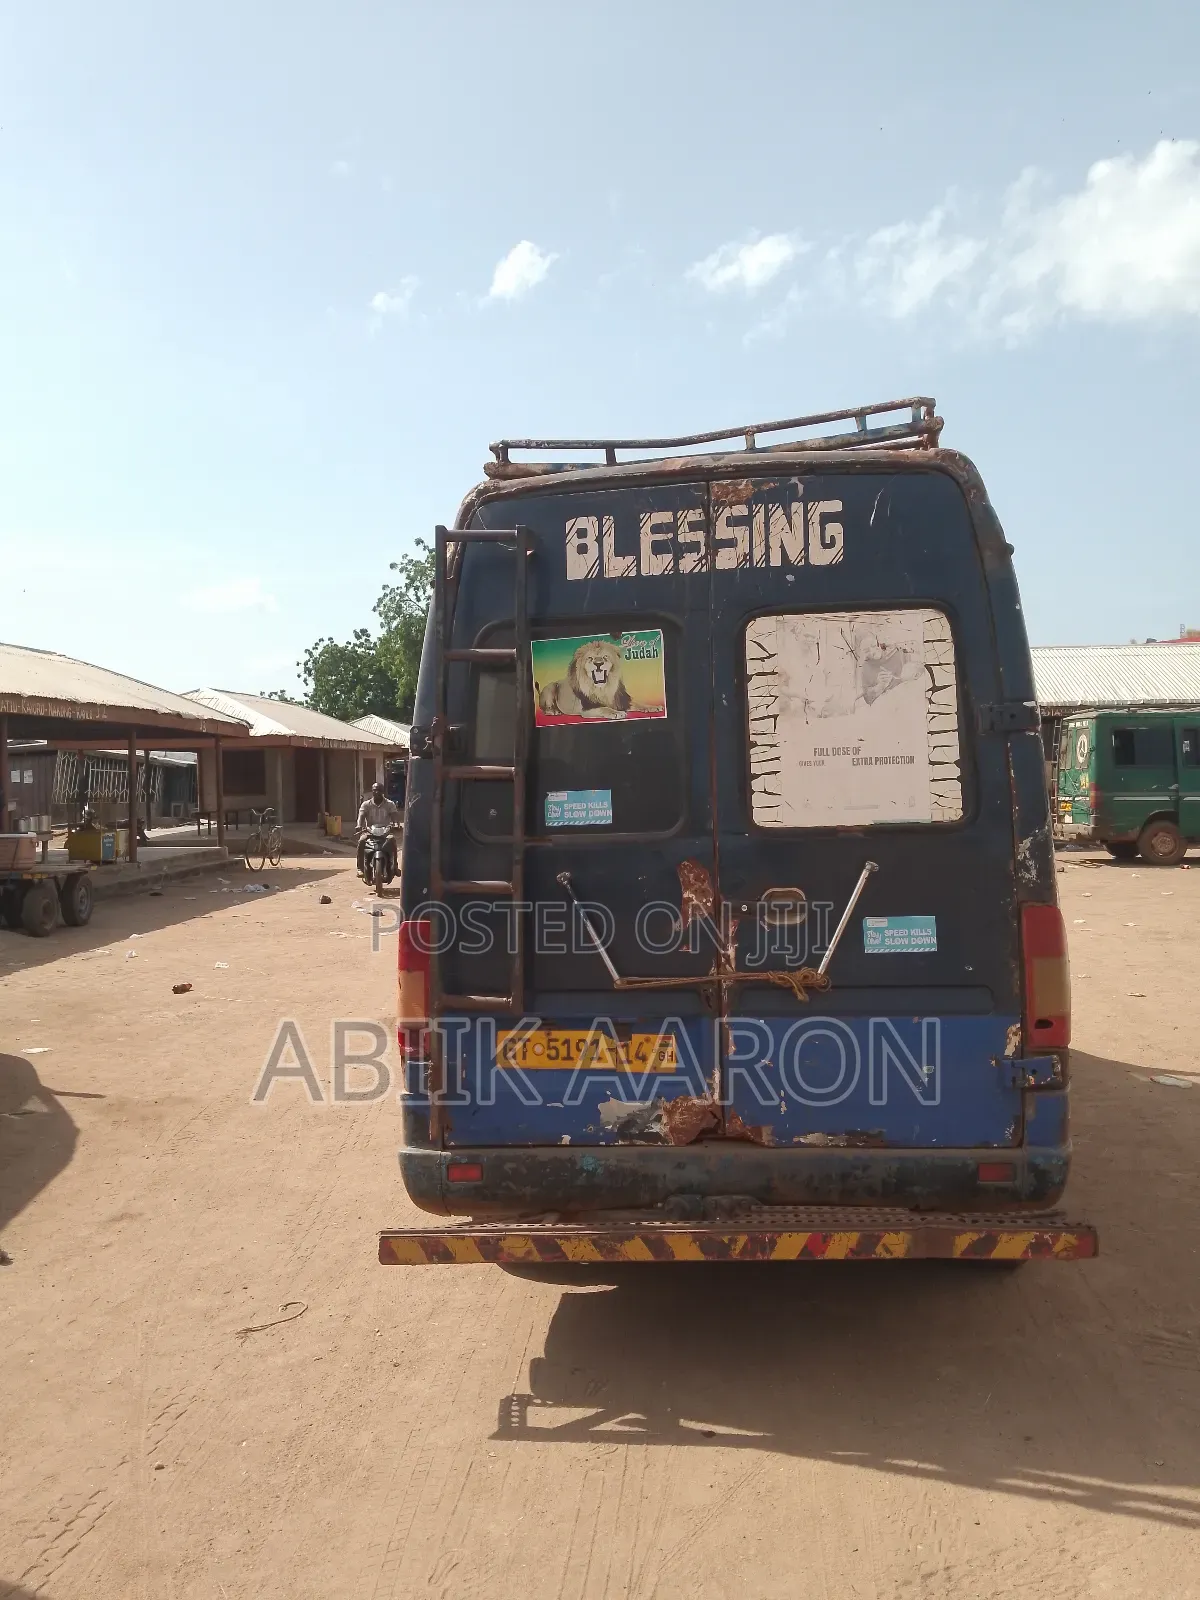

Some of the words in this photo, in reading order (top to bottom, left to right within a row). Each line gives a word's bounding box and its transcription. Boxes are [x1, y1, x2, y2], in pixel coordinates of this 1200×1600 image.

[565, 499, 844, 581] BLESSING
[624, 646, 659, 661] Judah
[813, 747, 830, 757] FULL
[832, 746, 851, 756] DOSE
[852, 746, 862, 756] OF
[852, 757, 873, 767] EXTRA
[874, 755, 915, 766] PROTECTION
[588, 801, 609, 809] KILLS
[564, 810, 587, 819] SLOW
[588, 809, 613, 817] DOWN
[884, 929, 909, 937] SPEED
[910, 928, 932, 936] KILLS
[885, 937, 909, 945] SLOW
[911, 936, 937, 945] DOWN
[660, 1050, 678, 1063] GH
